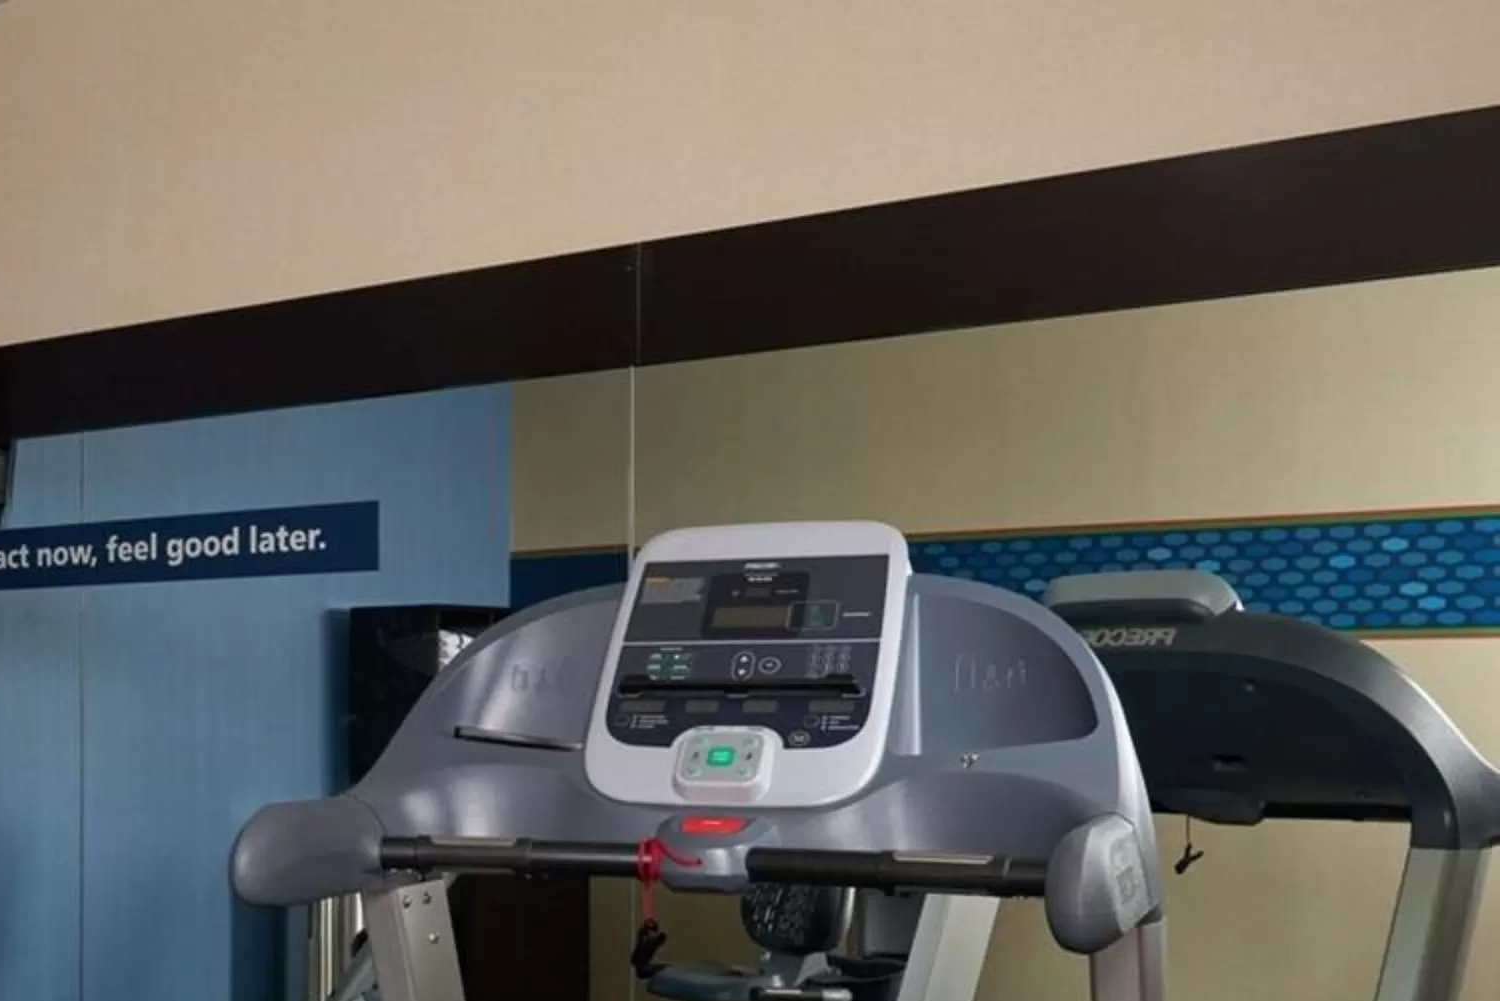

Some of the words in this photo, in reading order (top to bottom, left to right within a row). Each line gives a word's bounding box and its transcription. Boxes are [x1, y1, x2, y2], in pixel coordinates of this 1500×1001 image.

[36, 542, 97, 568] now,
[106, 532, 158, 564] feel
[166, 526, 240, 567] good
[249, 524, 327, 552] later.
